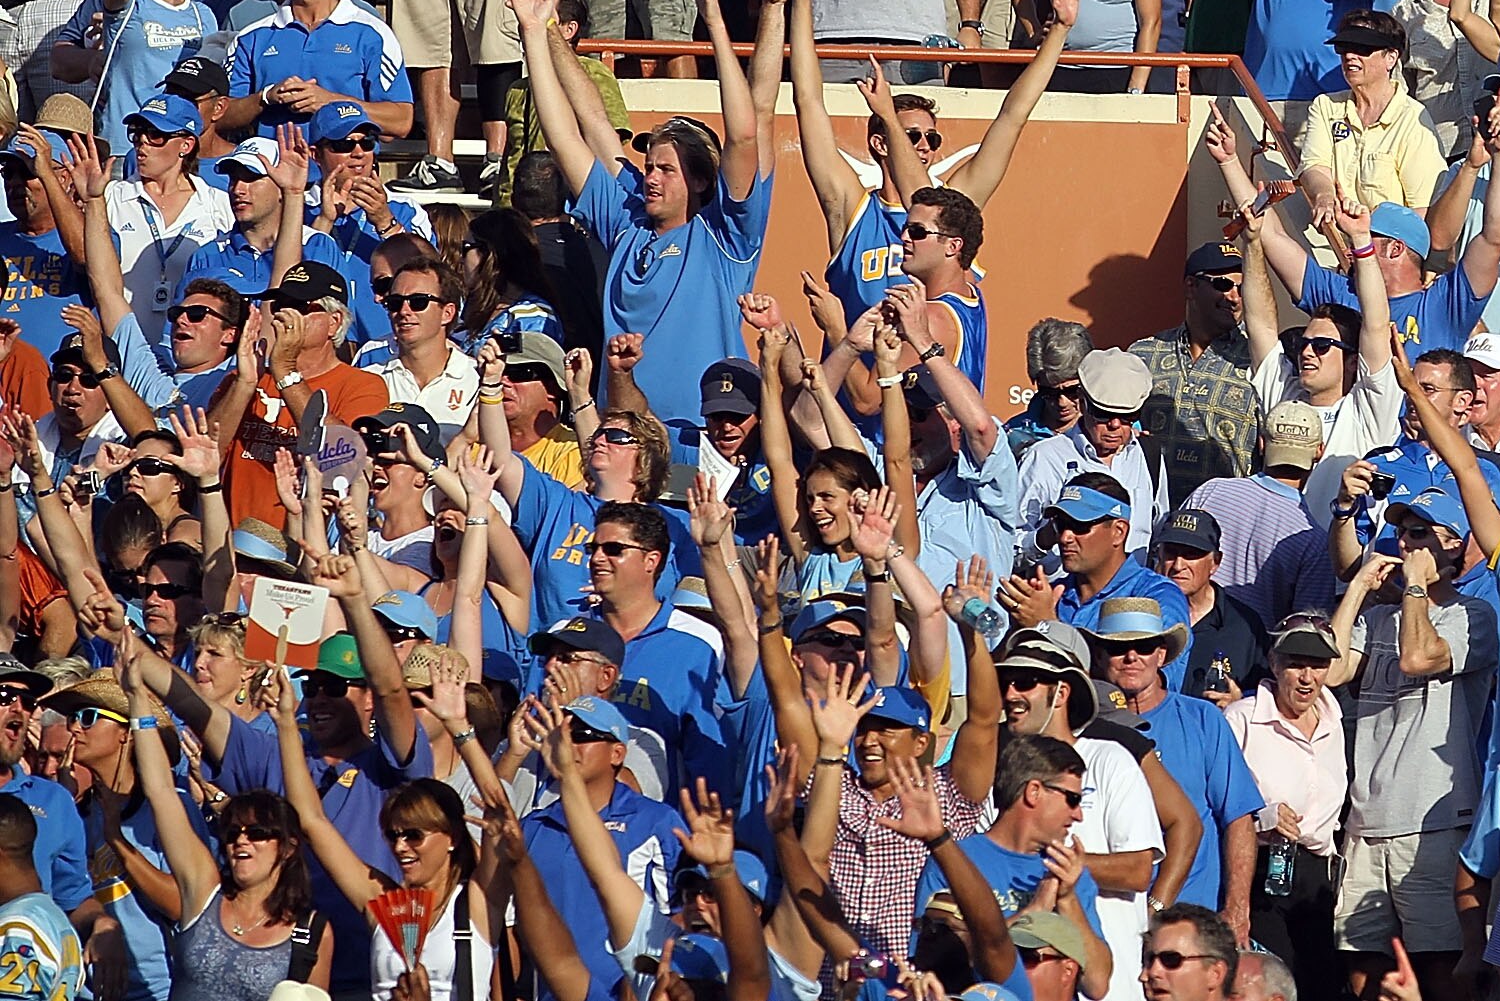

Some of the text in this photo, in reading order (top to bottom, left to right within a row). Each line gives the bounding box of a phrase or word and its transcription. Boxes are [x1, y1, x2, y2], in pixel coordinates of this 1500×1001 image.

[337, 104, 361, 118] Ucla
[861, 244, 905, 281] UC
[1464, 338, 1492, 354] Ucla
[719, 372, 733, 392] B
[904, 373, 917, 389] B
[448, 389, 462, 404] N
[1176, 448, 1199, 463] Ucla
[1061, 486, 1082, 500] Ucla
